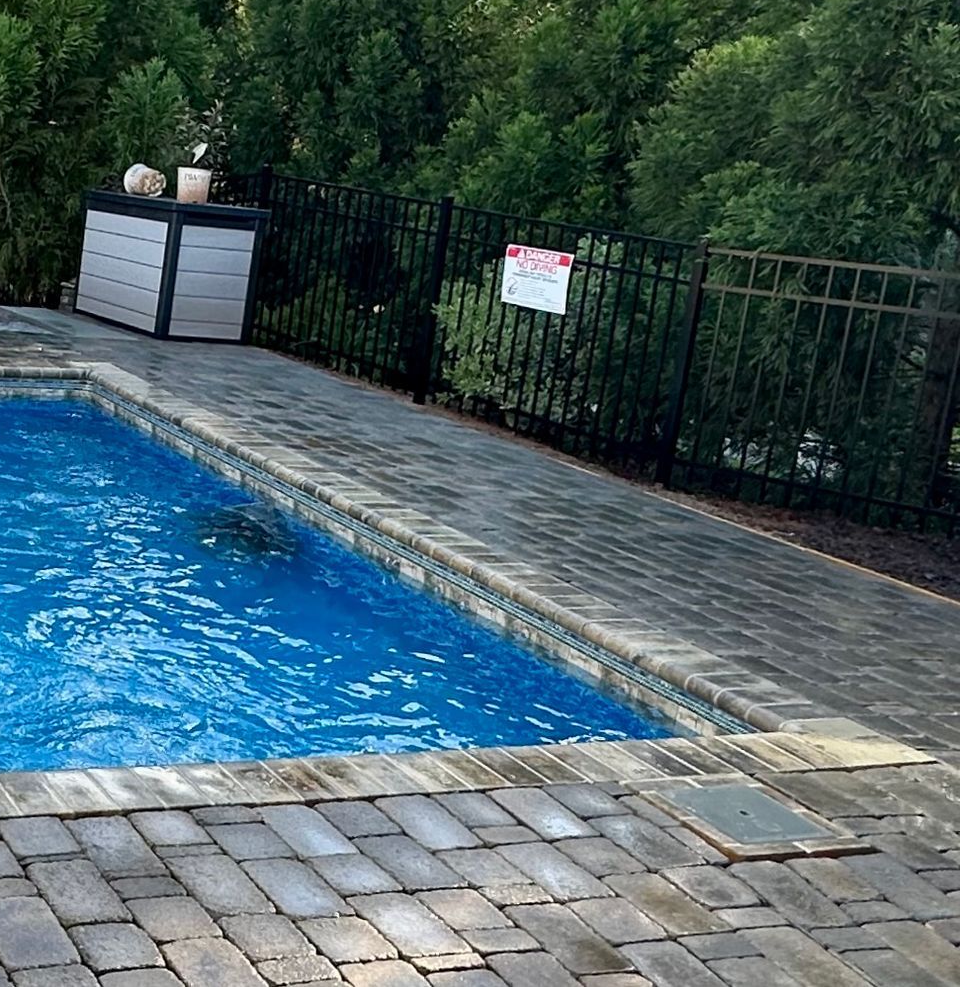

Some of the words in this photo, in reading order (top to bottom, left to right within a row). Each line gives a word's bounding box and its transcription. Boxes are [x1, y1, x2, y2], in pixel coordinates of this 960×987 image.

[526, 250, 560, 264] DANGER
[516, 260, 528, 269] NO
[530, 262, 558, 275] DIVING
